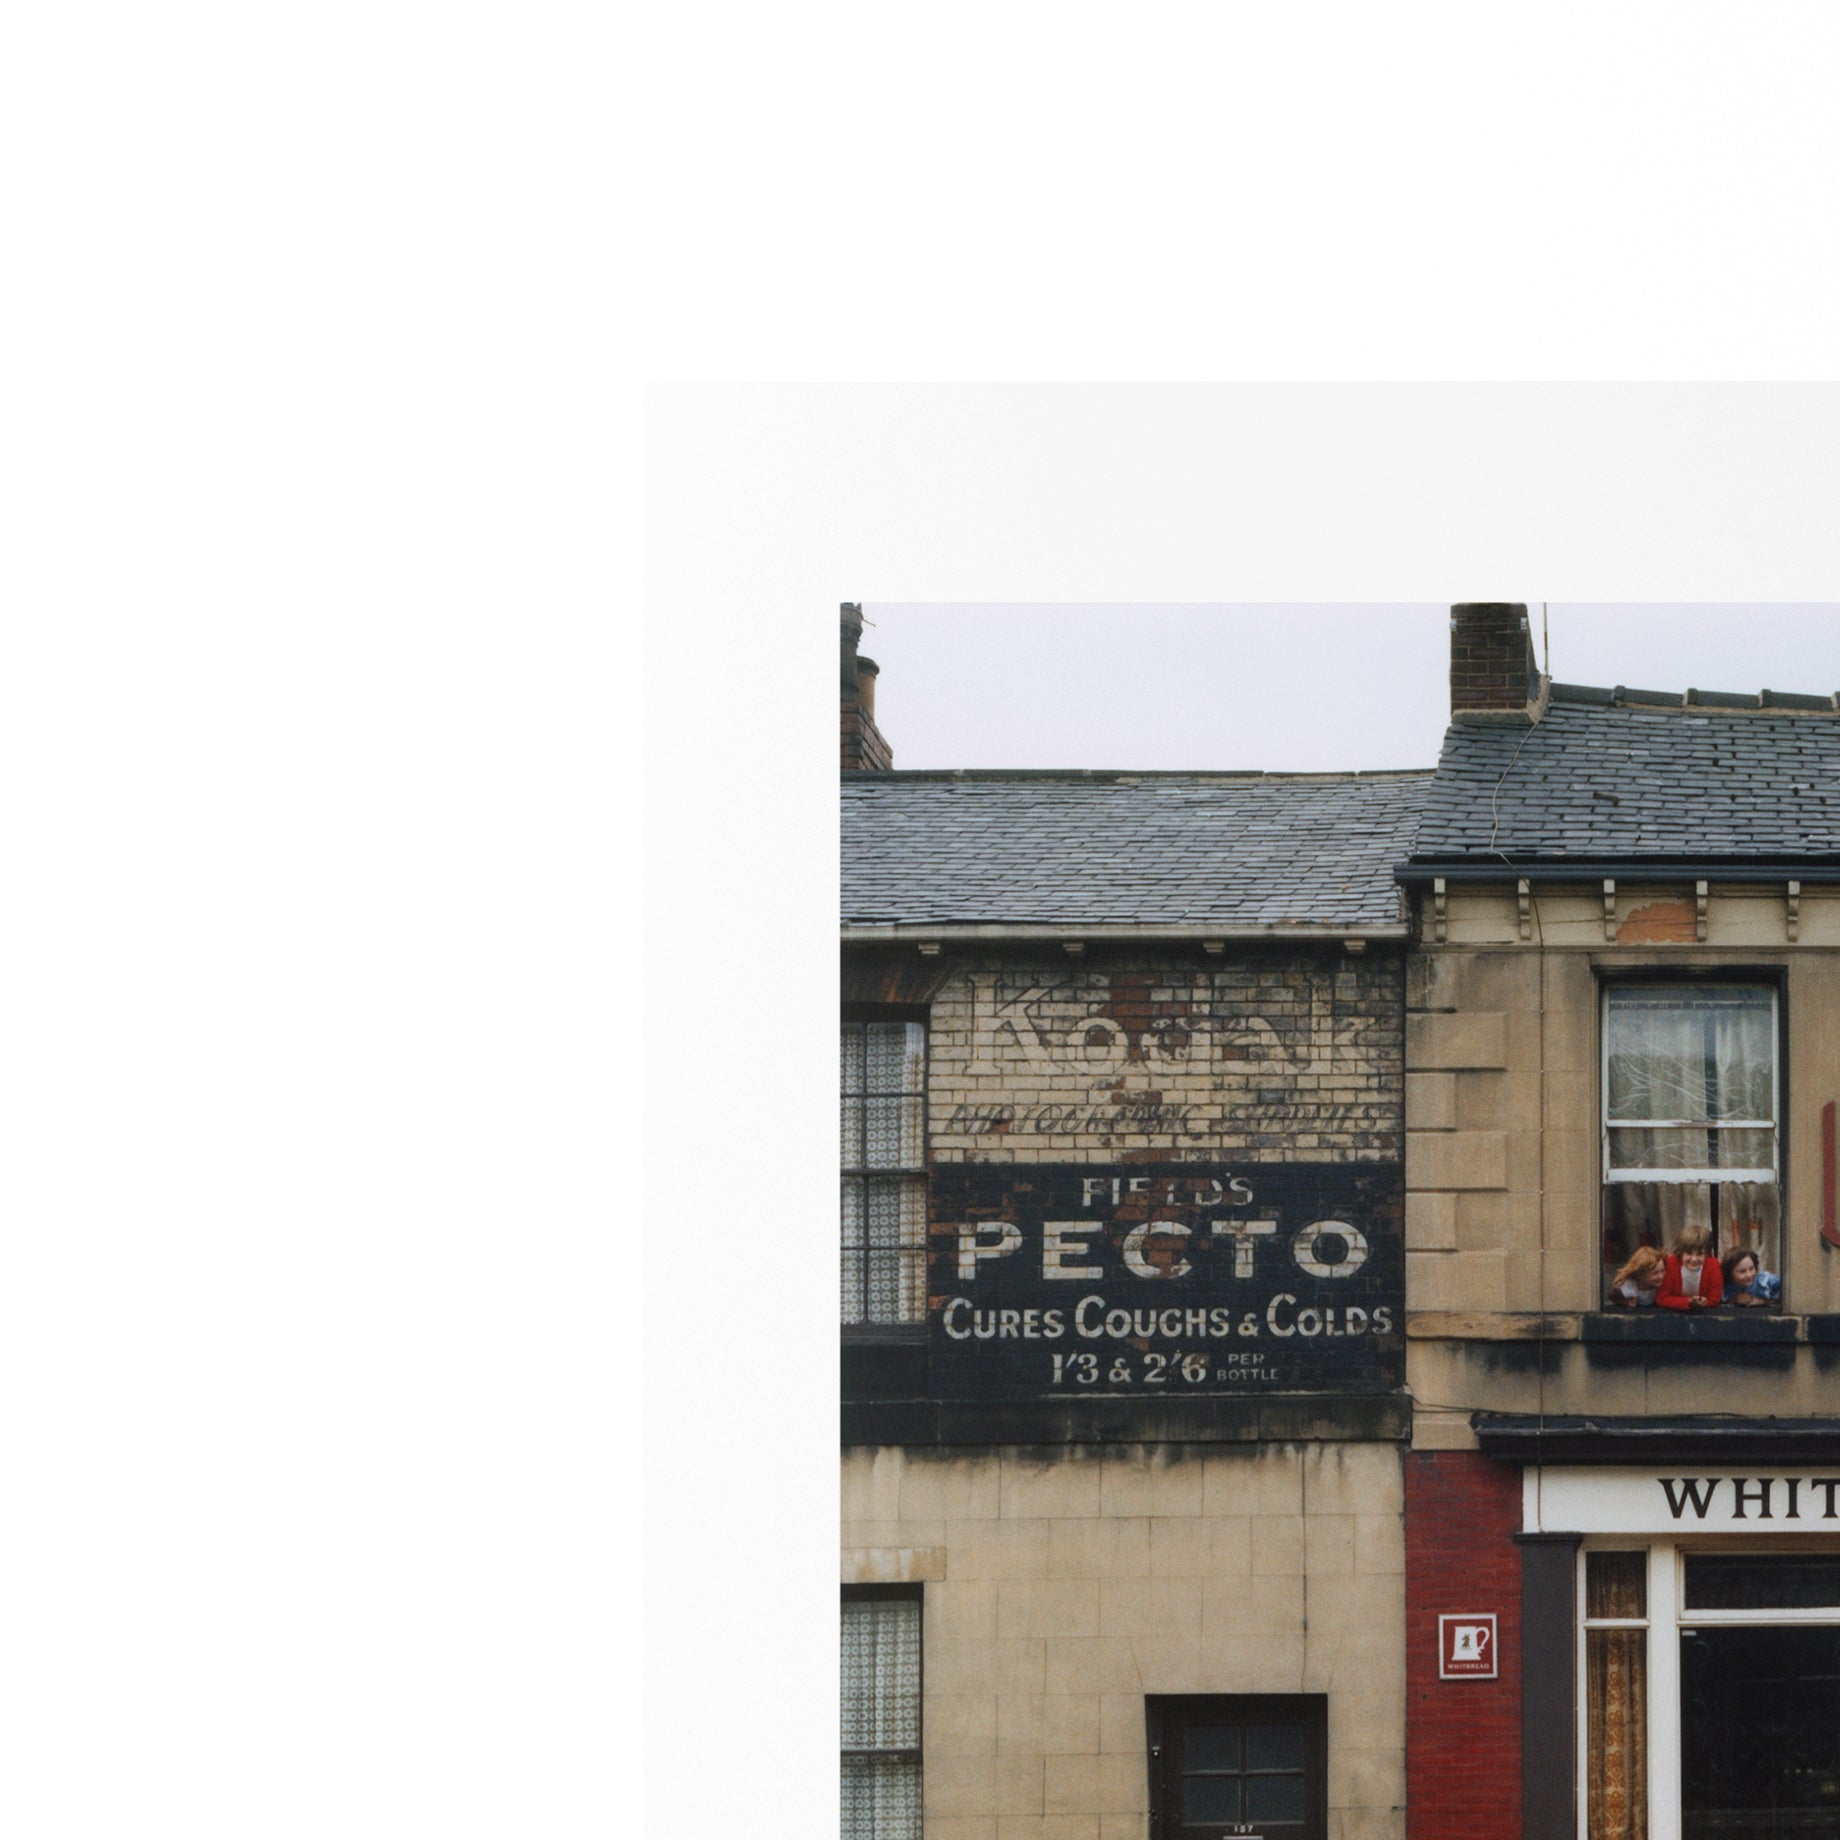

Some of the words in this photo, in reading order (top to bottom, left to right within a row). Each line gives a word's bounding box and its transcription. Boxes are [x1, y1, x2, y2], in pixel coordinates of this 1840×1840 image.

[964, 973, 1379, 1077] Kodak
[957, 1220, 1369, 1281] PECTO
[1237, 1311, 1259, 1338] &
[1108, 1357, 1132, 1384] &
[1227, 1353, 1265, 1365] PER
[1216, 1369, 1280, 1381] BOTTLE
